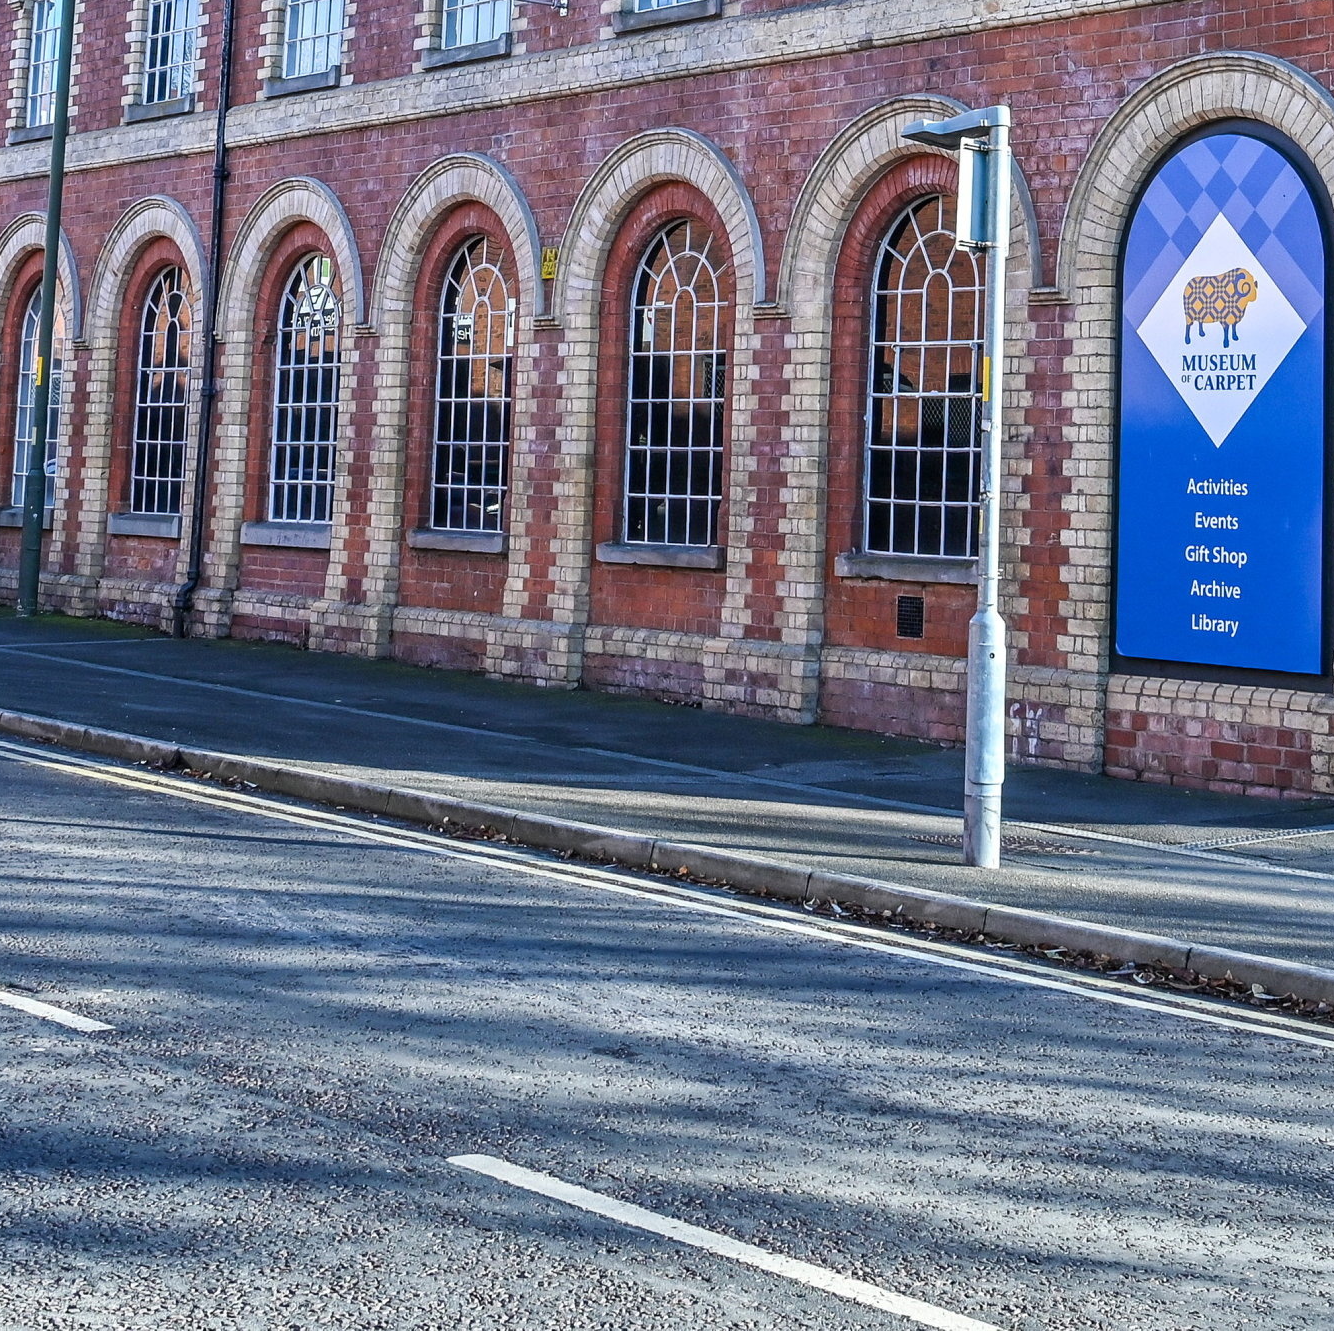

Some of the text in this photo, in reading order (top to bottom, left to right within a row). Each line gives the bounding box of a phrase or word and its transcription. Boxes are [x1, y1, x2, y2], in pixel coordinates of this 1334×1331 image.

[1181, 353, 1257, 371] MUSEUM
[1181, 375, 1257, 391] OF CARPET
[1187, 478, 1249, 496] Activities
[1195, 511, 1239, 530] Events
[1185, 545, 1248, 569] Gift Shop
[1191, 579, 1241, 599] Archive
[1191, 613, 1239, 637] Library
